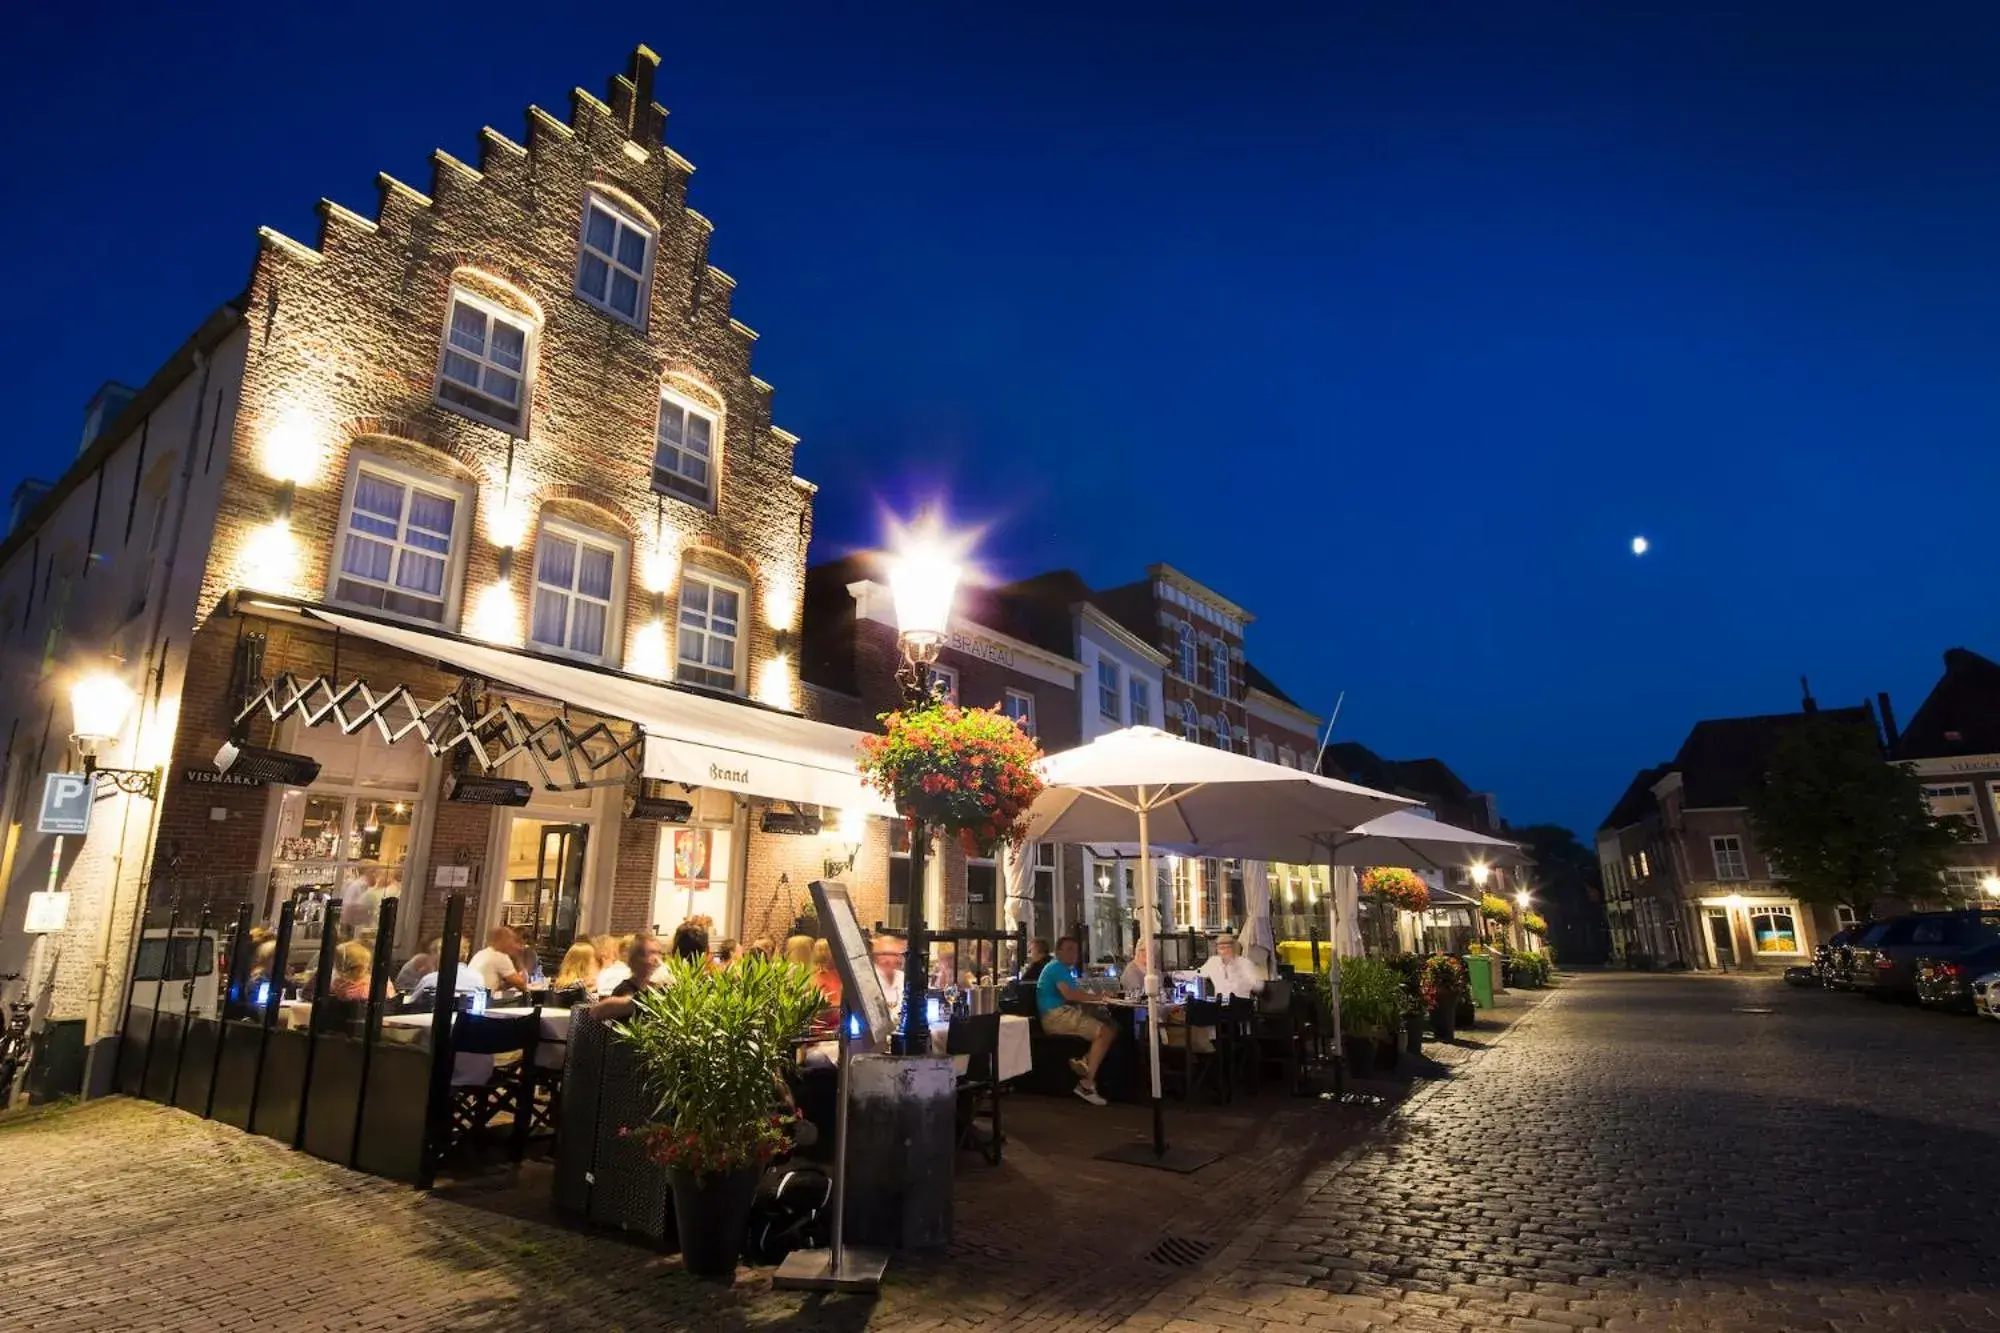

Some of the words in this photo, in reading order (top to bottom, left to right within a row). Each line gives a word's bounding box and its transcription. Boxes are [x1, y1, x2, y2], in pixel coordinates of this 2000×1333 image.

[952, 632, 1015, 667] BRAVEAU
[709, 762, 749, 784] Brand
[53, 779, 83, 808] P
